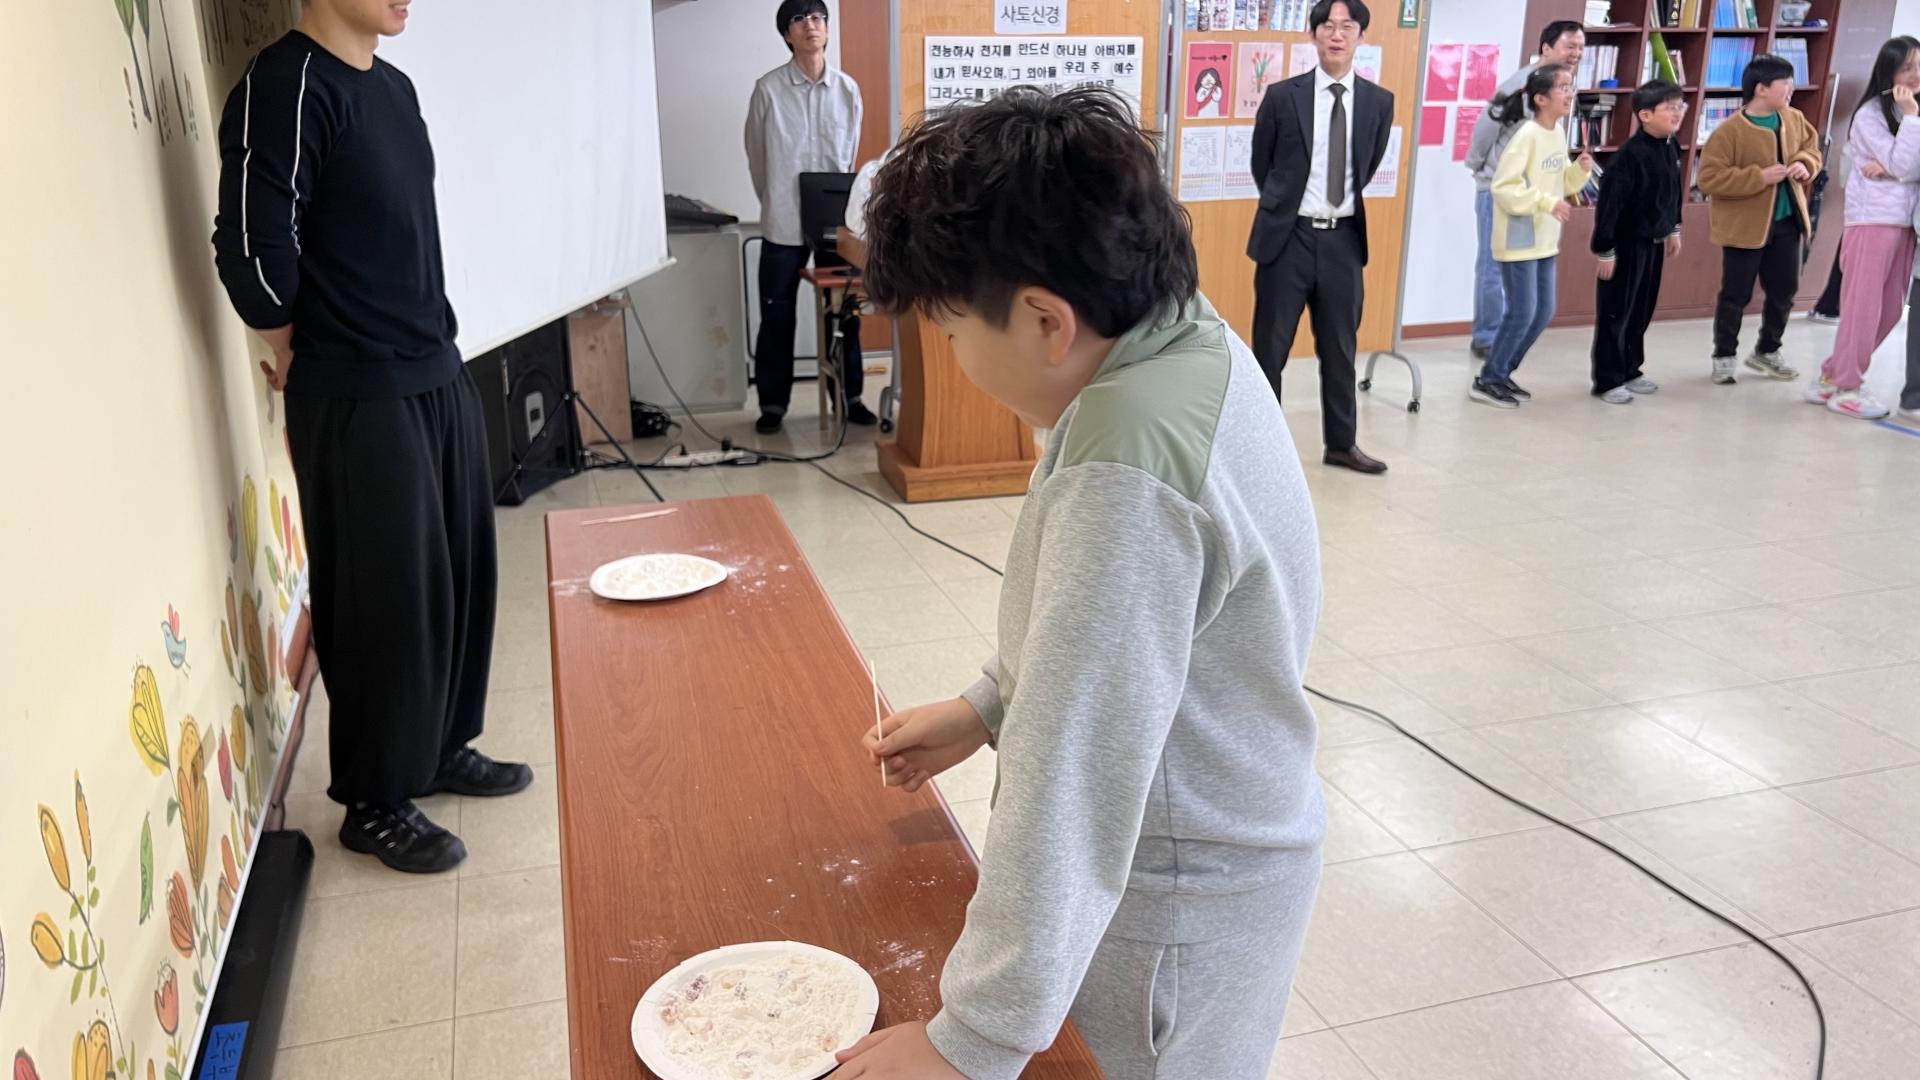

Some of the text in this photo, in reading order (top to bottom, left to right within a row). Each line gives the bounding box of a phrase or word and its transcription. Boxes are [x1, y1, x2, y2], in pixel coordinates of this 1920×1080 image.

[1000, 5, 1059, 24] 사도신경
[931, 43, 1136, 58] 전능하사 천지를 만드신 하나님 아버지를
[934, 67, 955, 79] 내가
[1010, 68, 1021, 80] 그
[1027, 66, 1057, 79] 외아들
[1064, 61, 1085, 73] 우리
[1090, 61, 1100, 73] 주
[1113, 62, 1134, 75] 예수
[930, 86, 984, 100] 그리스도를
